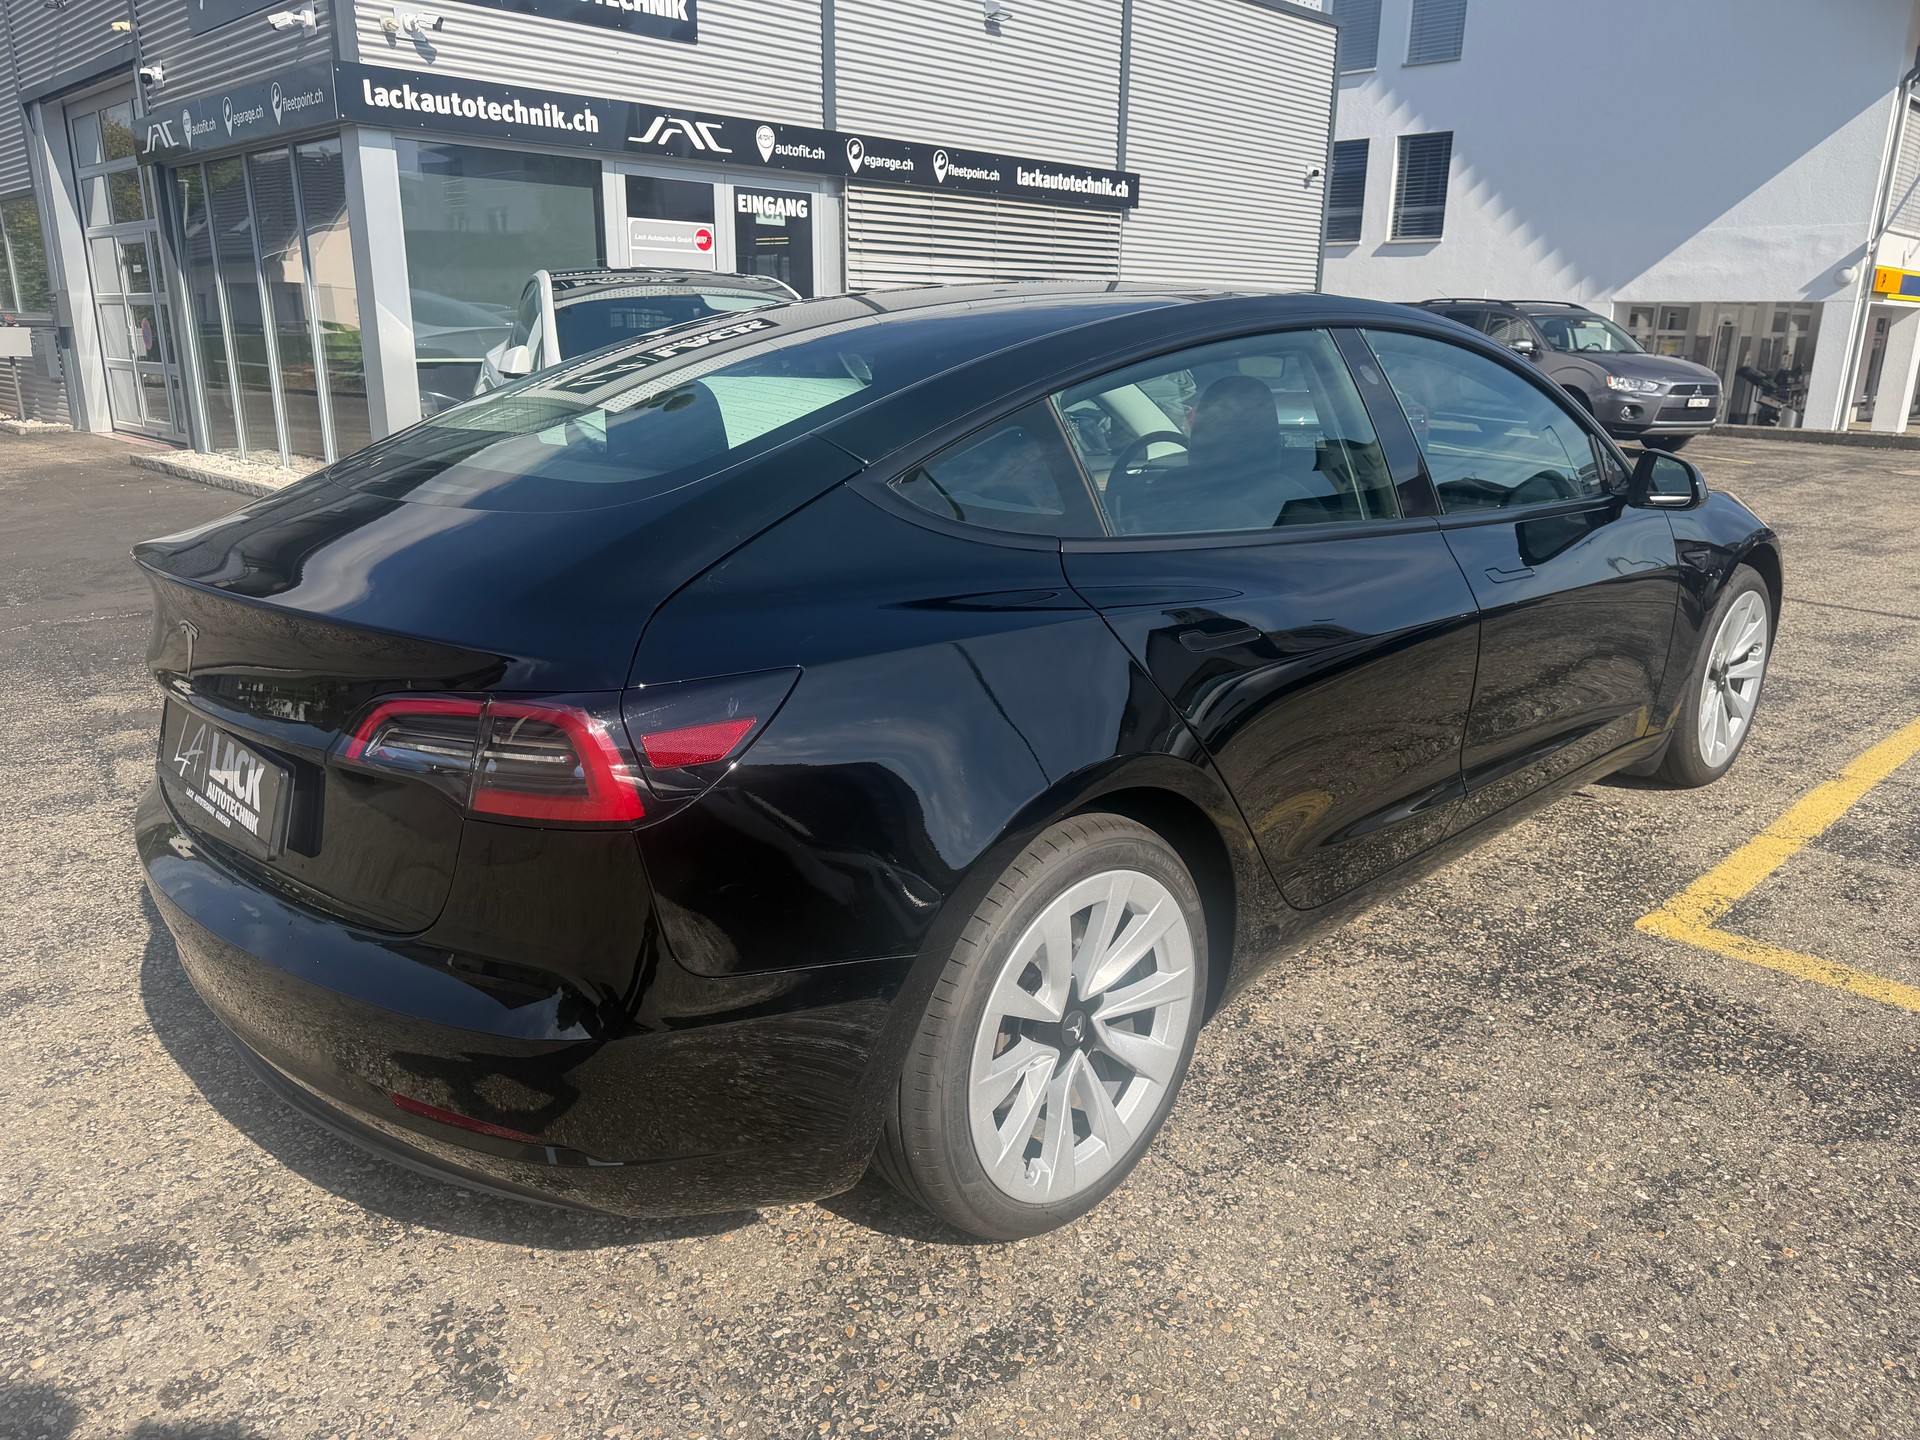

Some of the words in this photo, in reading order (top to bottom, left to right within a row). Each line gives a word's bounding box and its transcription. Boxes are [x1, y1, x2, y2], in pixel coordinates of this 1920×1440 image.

[282, 88, 324, 113] fleetpoint.ch
[362, 79, 599, 133] lackautotechnik.ch
[191, 118, 217, 136] autofit.ch
[233, 105, 264, 127] egarage.ch
[775, 144, 825, 160] autofit.ch
[863, 155, 914, 172] egarage.ch
[948, 163, 1000, 182] fleetpoint.ch
[1016, 166, 1129, 198] lackautotechnik.ch
[737, 193, 808, 218] EINGANG
[208, 731, 266, 813] LACK
[205, 781, 260, 836] AUTOTECHNIK
